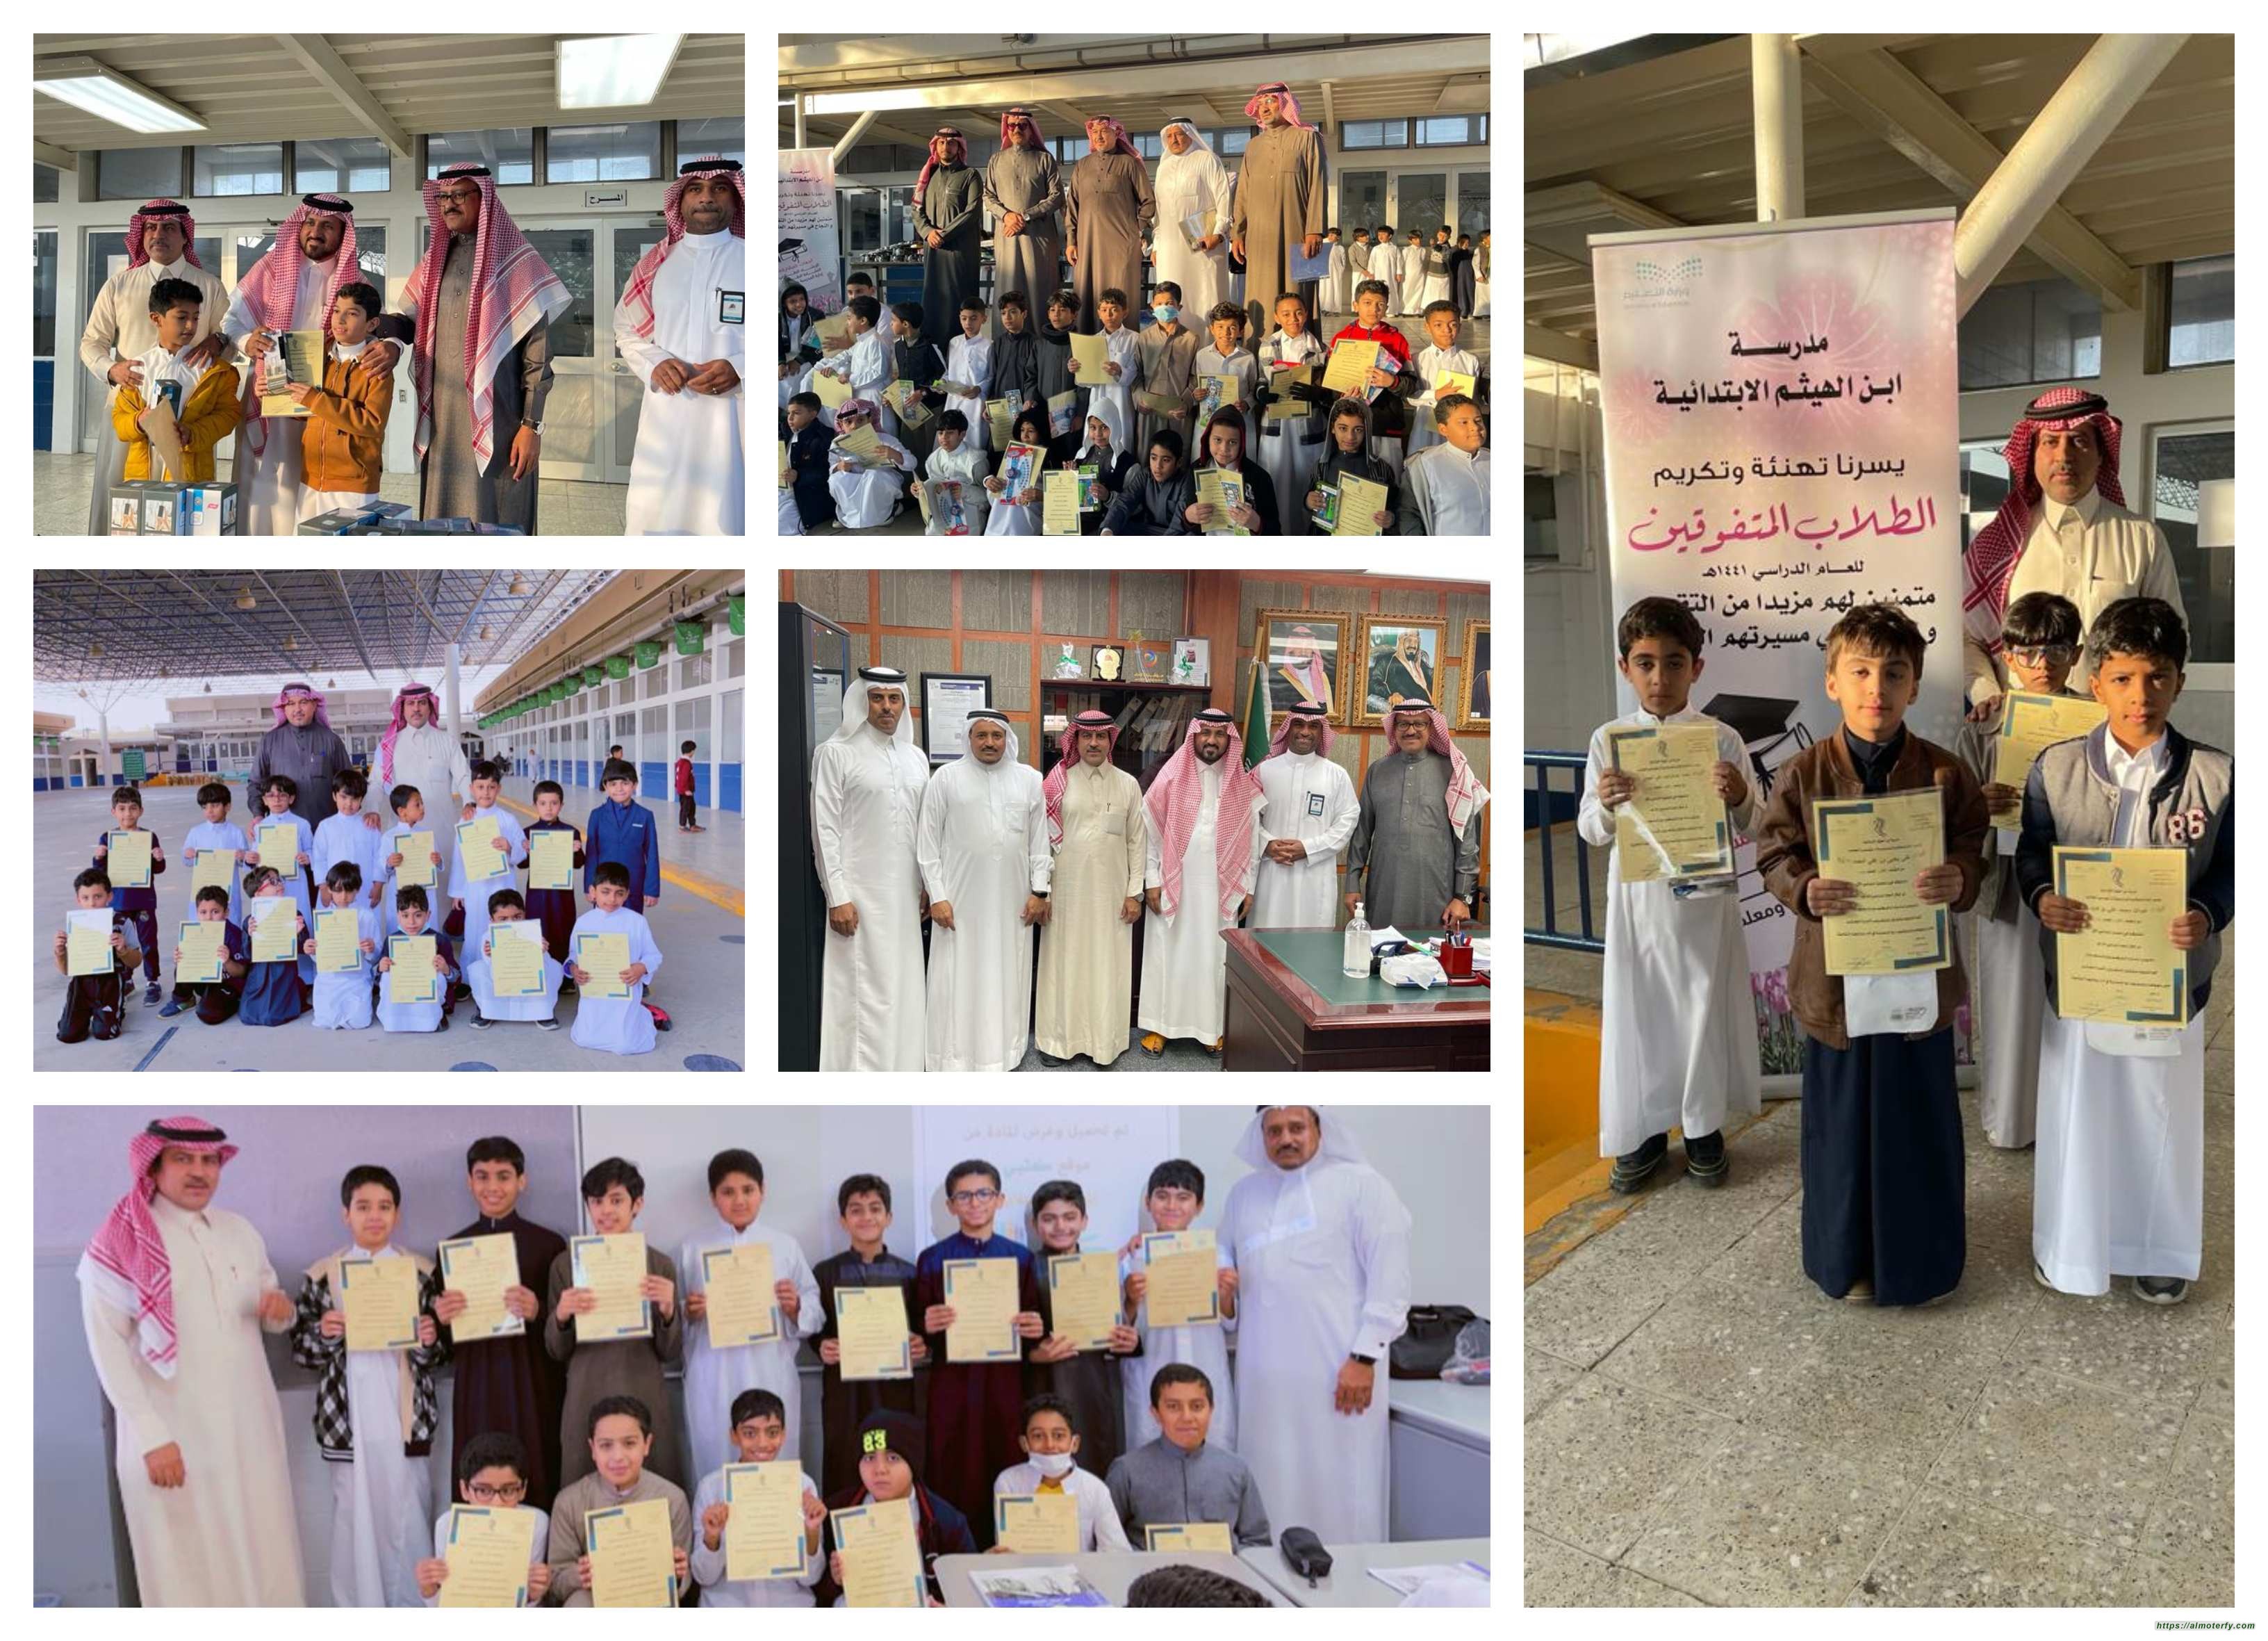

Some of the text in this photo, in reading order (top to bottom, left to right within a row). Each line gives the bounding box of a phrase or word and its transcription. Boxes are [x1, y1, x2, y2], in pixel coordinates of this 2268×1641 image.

[589, 194, 623, 204] المسرح
[1728, 332, 1829, 360] مدرسة
[1654, 372, 1902, 411] ابن الهيثم الابتدائية
[1654, 453, 1905, 487] يسرنا تهنئة وتكريم
[1628, 494, 1937, 554] الطلاب المتفوقين
[1752, 562, 1811, 582] الدراسي
[1814, 560, 1864, 576] للعام
[1722, 594, 1750, 617] من
[1757, 591, 1814, 615] مزيدا
[1820, 589, 1855, 613] لهم
[1720, 625, 1810, 649] مسيرتهم
[1742, 904, 1785, 926] ومعل
